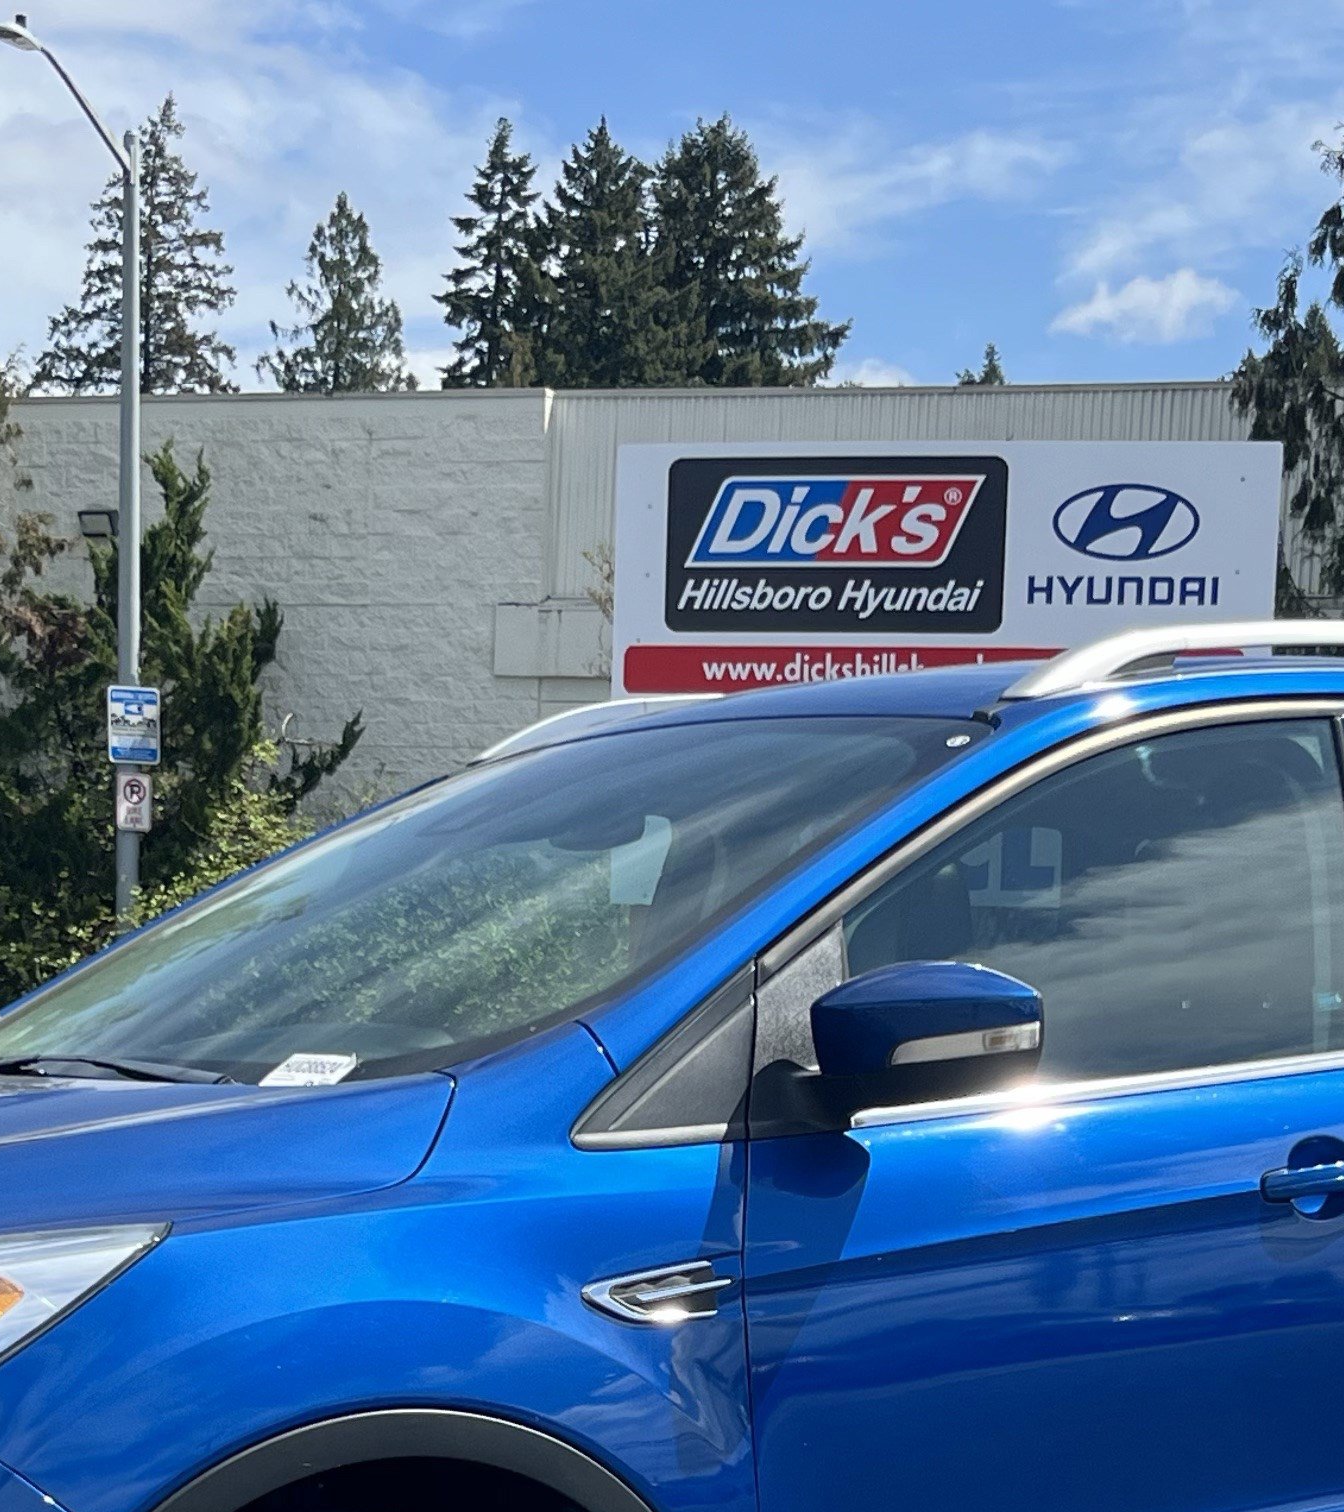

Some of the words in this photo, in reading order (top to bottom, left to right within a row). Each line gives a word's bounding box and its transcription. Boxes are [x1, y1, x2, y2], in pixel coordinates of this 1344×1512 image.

[709, 486, 946, 555] Dick's
[677, 579, 832, 611] Hillsboro
[837, 579, 984, 619] Hyundai
[1027, 576, 1219, 606] HYUNDAI
